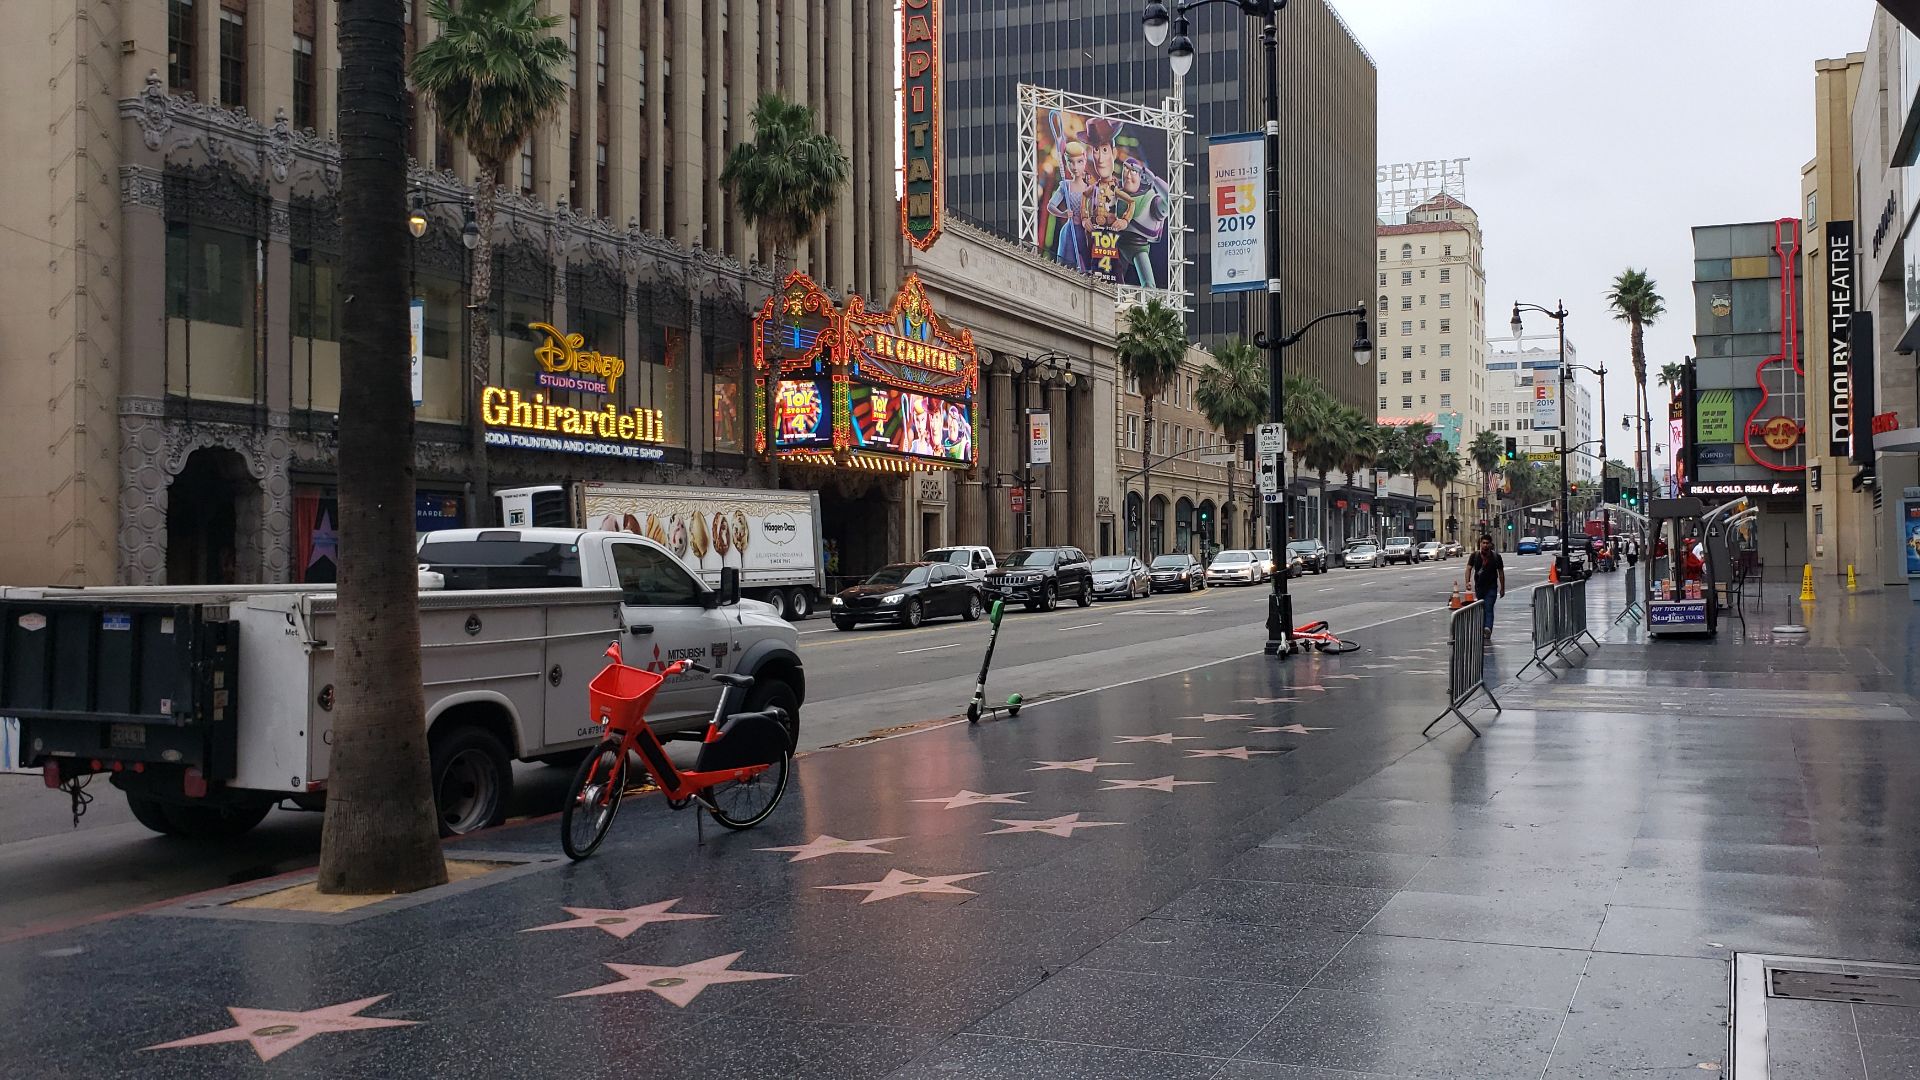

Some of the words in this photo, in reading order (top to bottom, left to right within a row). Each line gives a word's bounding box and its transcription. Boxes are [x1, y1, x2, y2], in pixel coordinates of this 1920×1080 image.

[1215, 169, 1235, 178] JUNE
[1238, 166, 1258, 176] 11-13
[1216, 183, 1257, 216] E3
[1217, 215, 1256, 233] 2019
[1091, 231, 1120, 249] TOY
[1217, 238, 1257, 248] E3EXPO.COM
[1094, 248, 1117, 256] STORY
[1097, 256, 1112, 273] 4
[1831, 234, 1850, 333] THEATRE
[528, 321, 625, 393] Disney
[875, 333, 895, 357] EL
[895, 339, 958, 373] CAPITAN
[539, 374, 575, 389] STUDIO
[576, 378, 607, 393] STORE
[783, 389, 814, 407] TOY
[1536, 386, 1555, 399] E3
[871, 395, 888, 413] TOY
[1536, 399, 1555, 407] 2019
[482, 385, 666, 443] Ghirardelli
[790, 413, 806, 431] 4
[875, 419, 884, 436] 4
[1032, 428, 1048, 439] E3
[1750, 423, 1781, 436] Hard
[511, 433, 562, 450] FOUNTAIN
[562, 440, 584, 453] AND
[584, 442, 639, 458] CHOCOLATE
[639, 447, 664, 459] SHOP
[1715, 485, 1743, 493] GOLD.
[1744, 485, 1769, 493] REAL
[1651, 612, 1685, 622] Starline
[577, 728, 587, 737] CA
